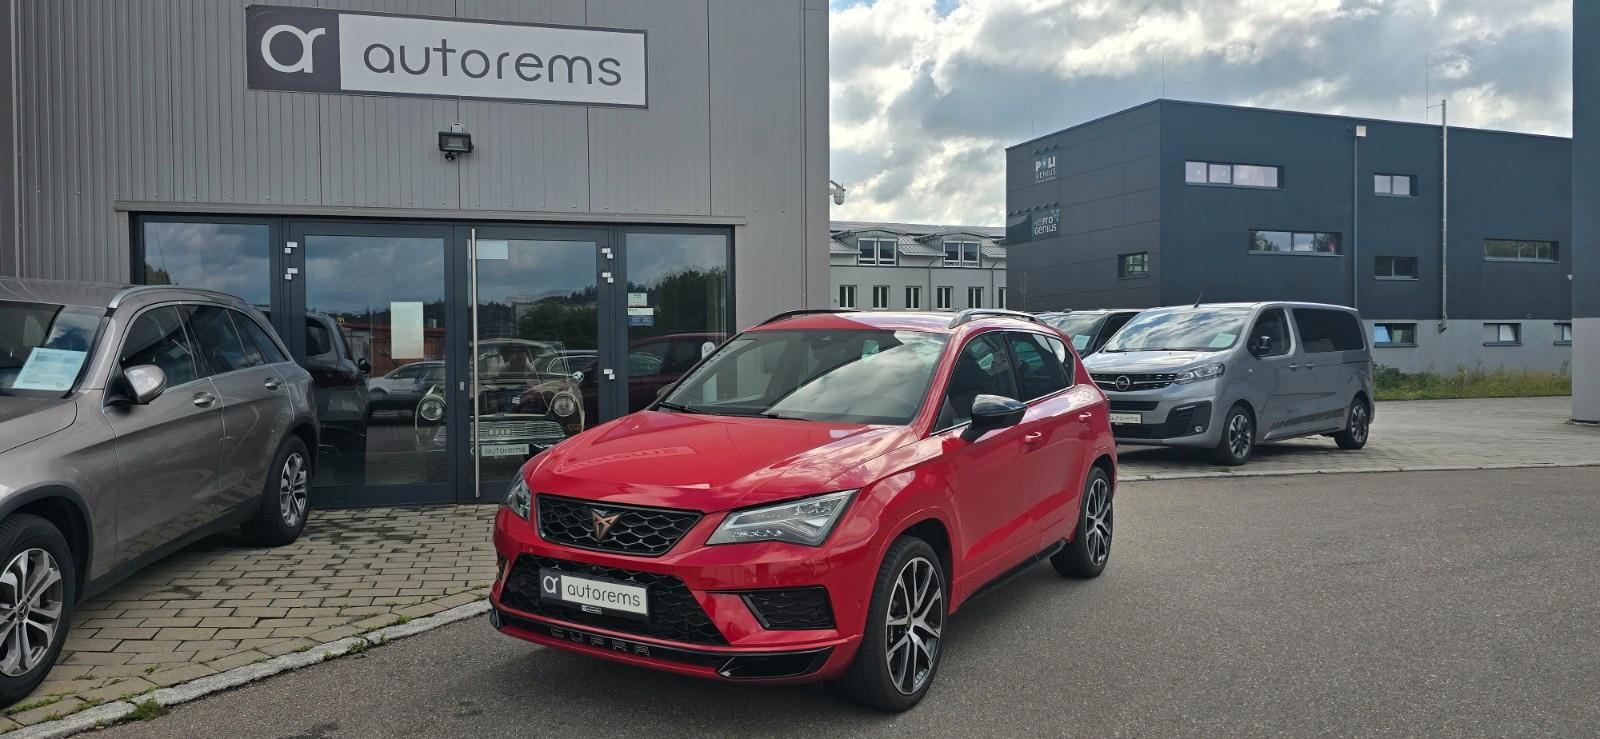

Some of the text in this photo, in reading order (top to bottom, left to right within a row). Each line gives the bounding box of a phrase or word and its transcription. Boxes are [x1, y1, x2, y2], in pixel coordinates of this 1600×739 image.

[363, 38, 622, 86] autorems
[485, 447, 526, 455] autorems
[567, 584, 641, 607] autorems
[551, 627, 650, 656] CUPRA
